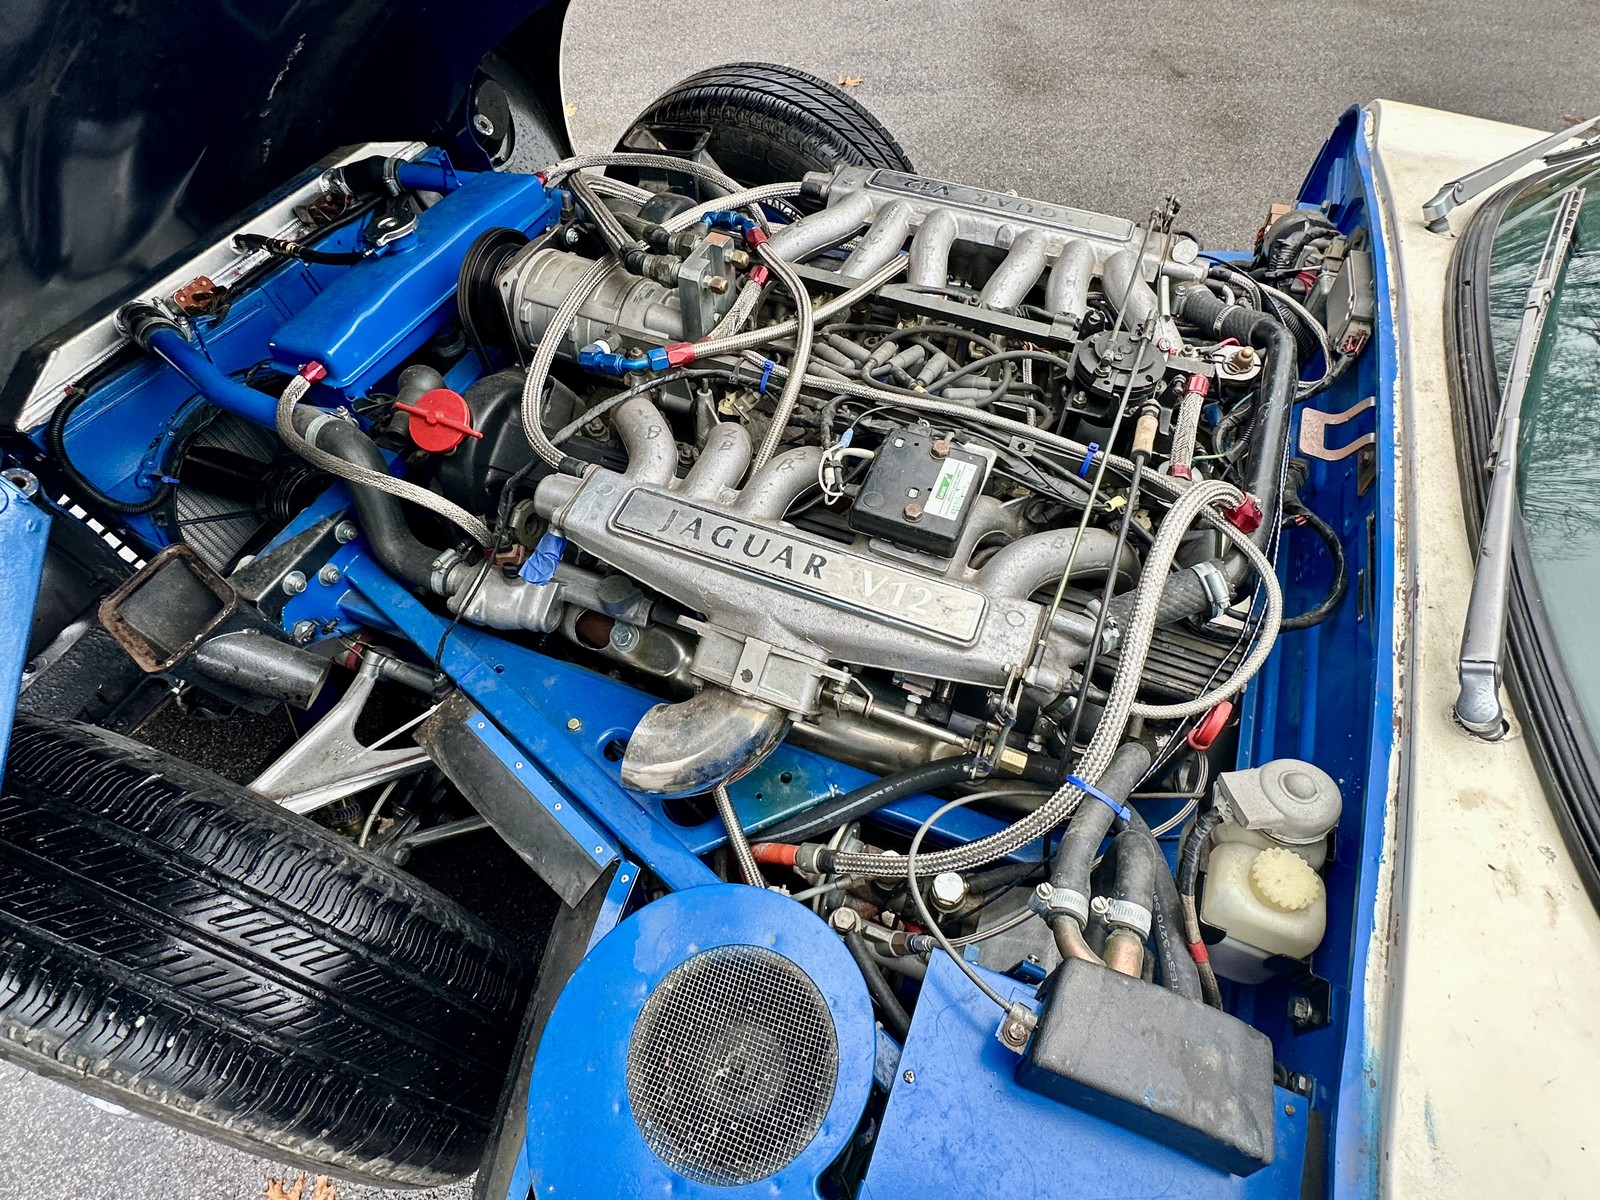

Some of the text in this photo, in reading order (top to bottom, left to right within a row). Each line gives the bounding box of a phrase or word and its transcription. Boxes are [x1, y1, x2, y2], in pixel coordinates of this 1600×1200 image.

[903, 177, 950, 197] V12
[657, 508, 934, 616] JAGUAR V12
[1156, 914, 1170, 948] 3270
